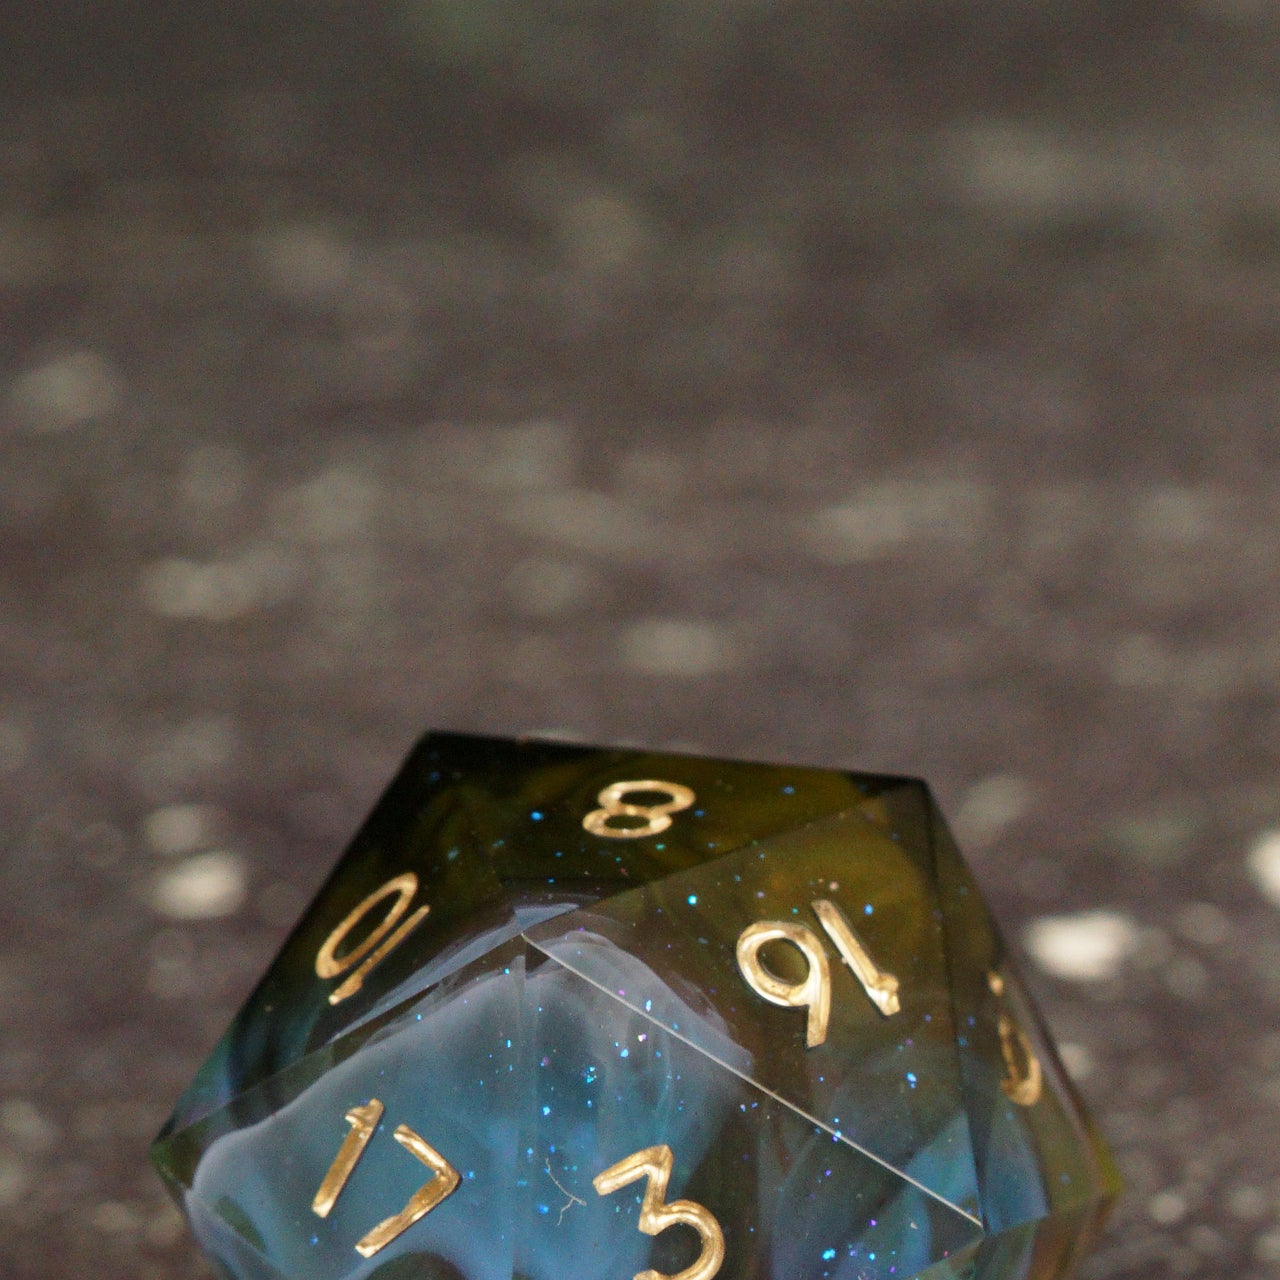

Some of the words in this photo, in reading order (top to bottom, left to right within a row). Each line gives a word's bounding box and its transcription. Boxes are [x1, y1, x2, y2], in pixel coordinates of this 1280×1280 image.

[583, 779, 696, 839] 8
[314, 870, 431, 1007] 10
[311, 1098, 462, 1259] 17
